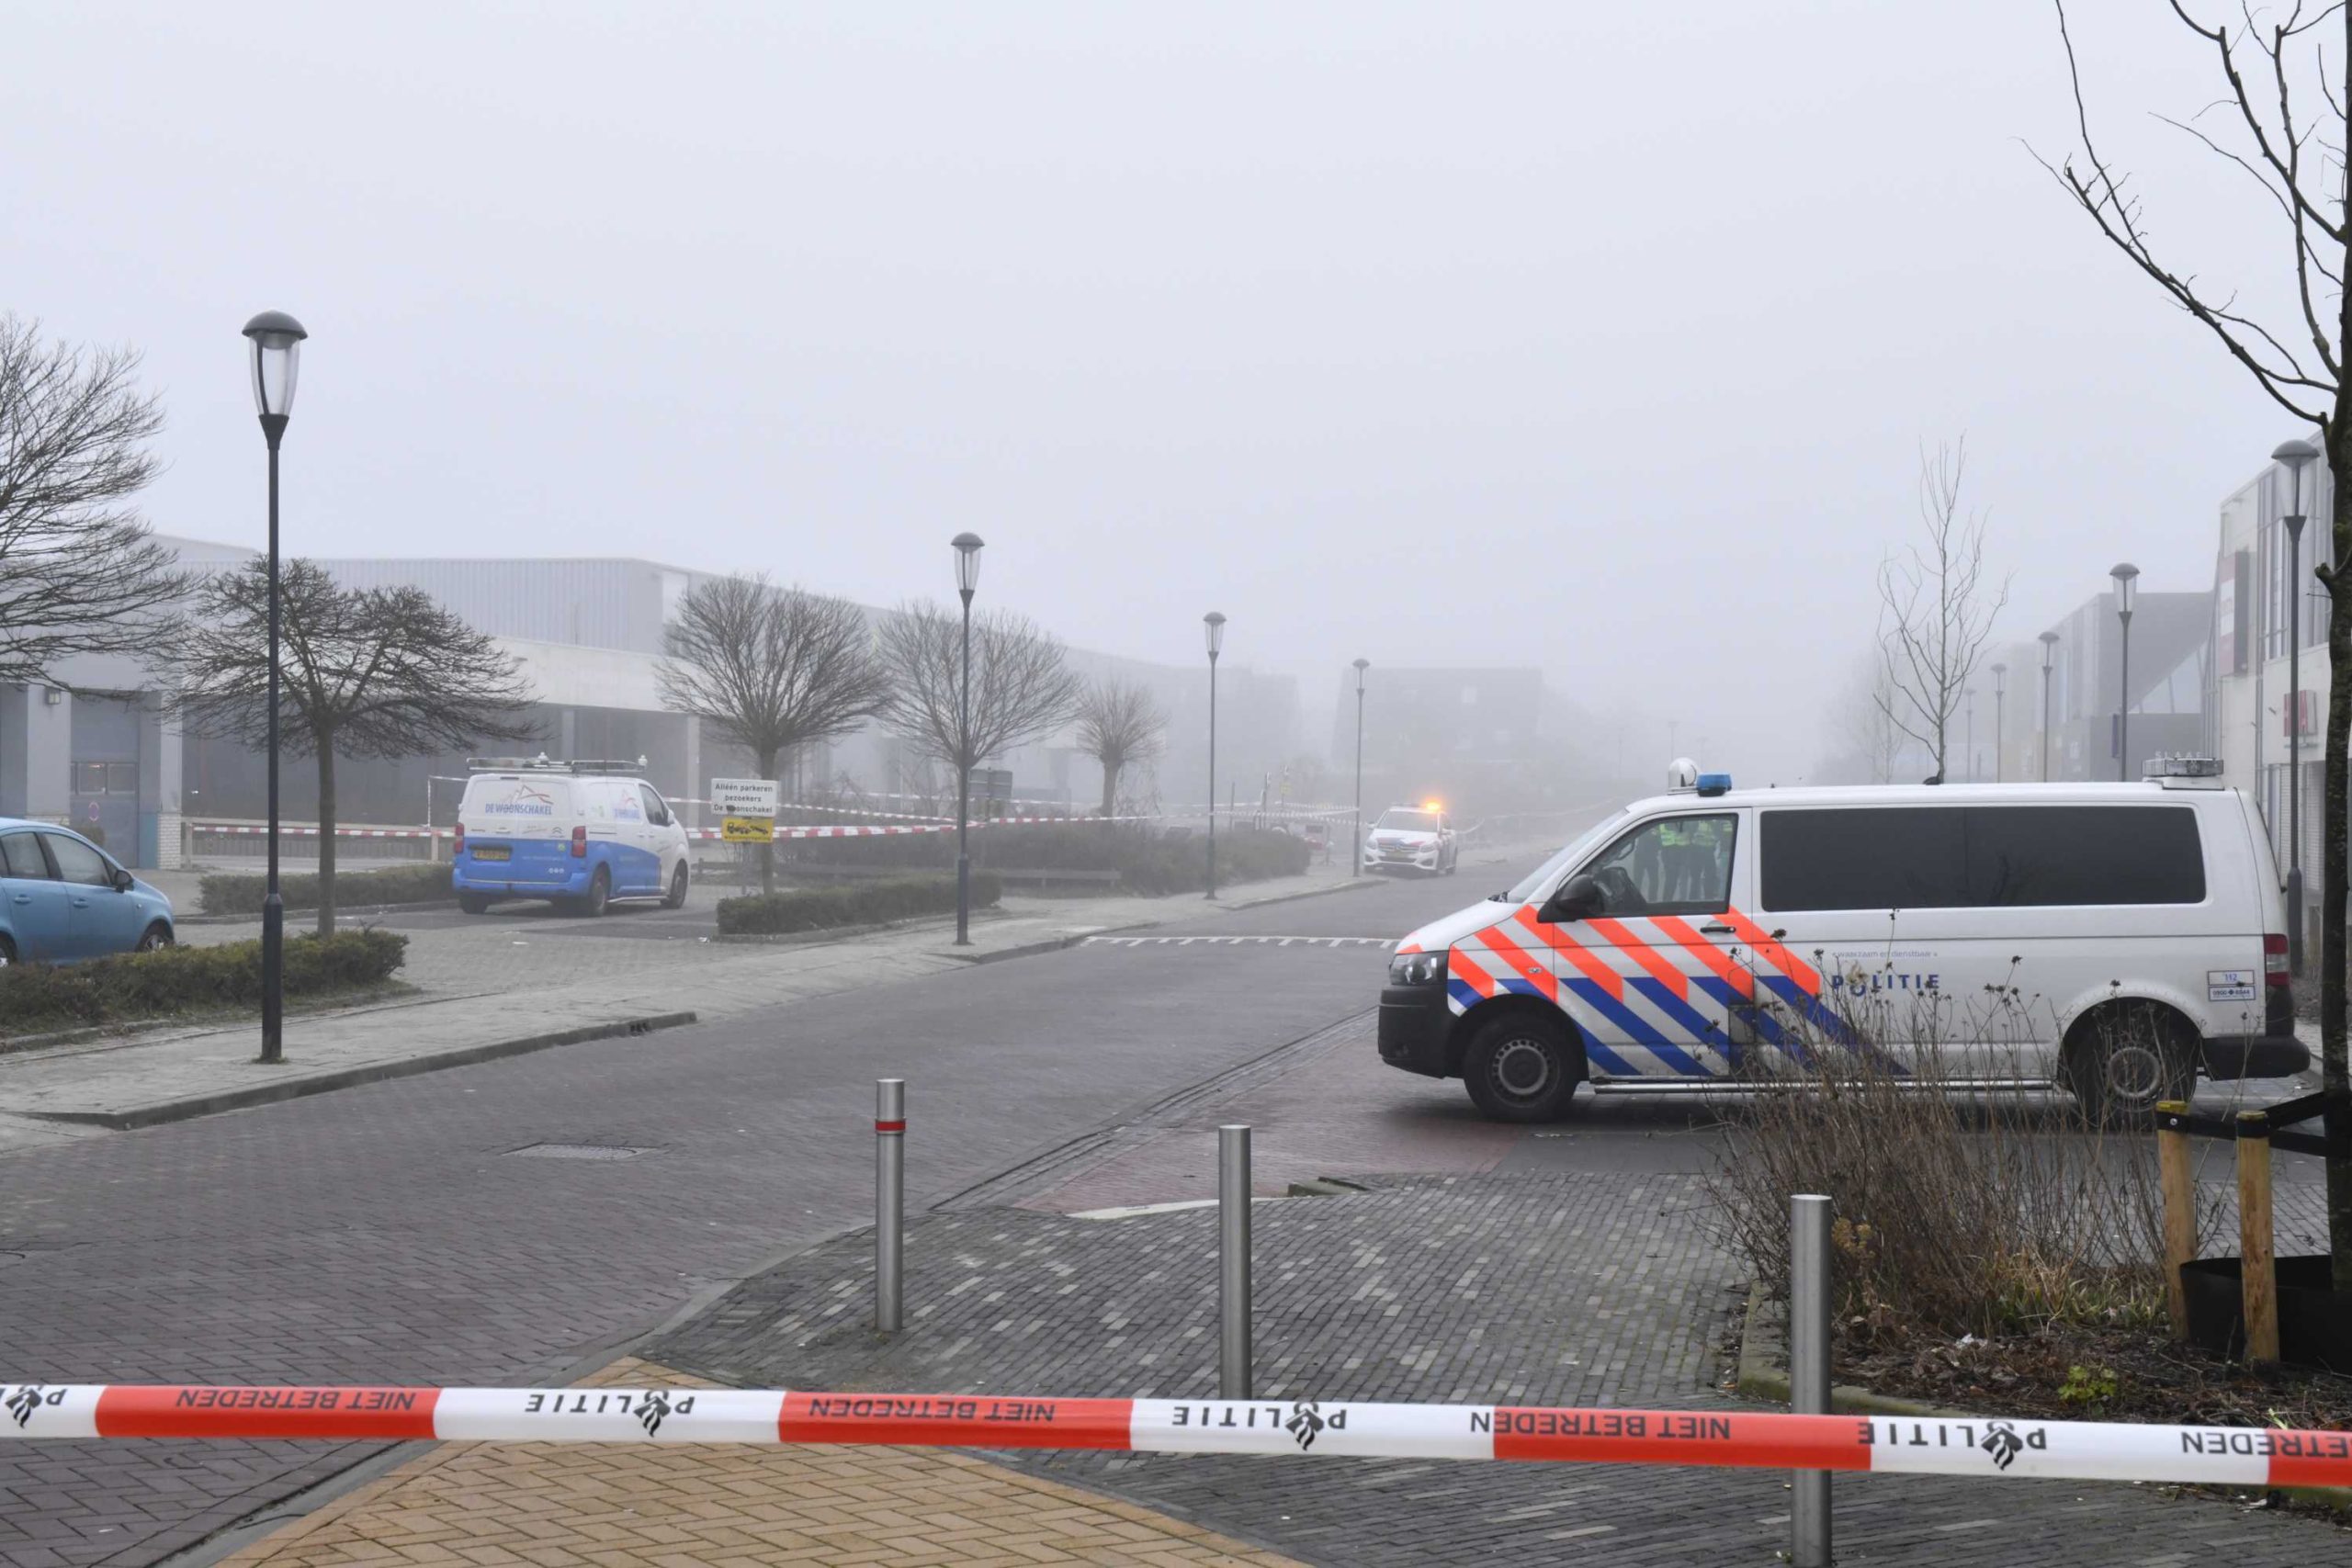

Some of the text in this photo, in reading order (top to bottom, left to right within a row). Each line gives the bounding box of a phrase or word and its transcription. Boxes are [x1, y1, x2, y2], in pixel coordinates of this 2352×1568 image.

[740, 784, 773, 793] parkeren
[485, 803, 552, 816] DE WOONSCHAKEL
[2225, 973, 2238, 981] 112
[175, 1389, 416, 1411] NIET BETREDEN
[525, 1390, 695, 1416] POLITIE
[809, 1398, 1055, 1422] NIET BETREDEN
[1171, 1402, 1348, 1430] POLITIE
[1470, 1412, 1731, 1440] NIET BETREDEN
[1858, 1421, 2047, 1451] POLITIE
[2181, 1431, 2352, 1459] ETREDEN
